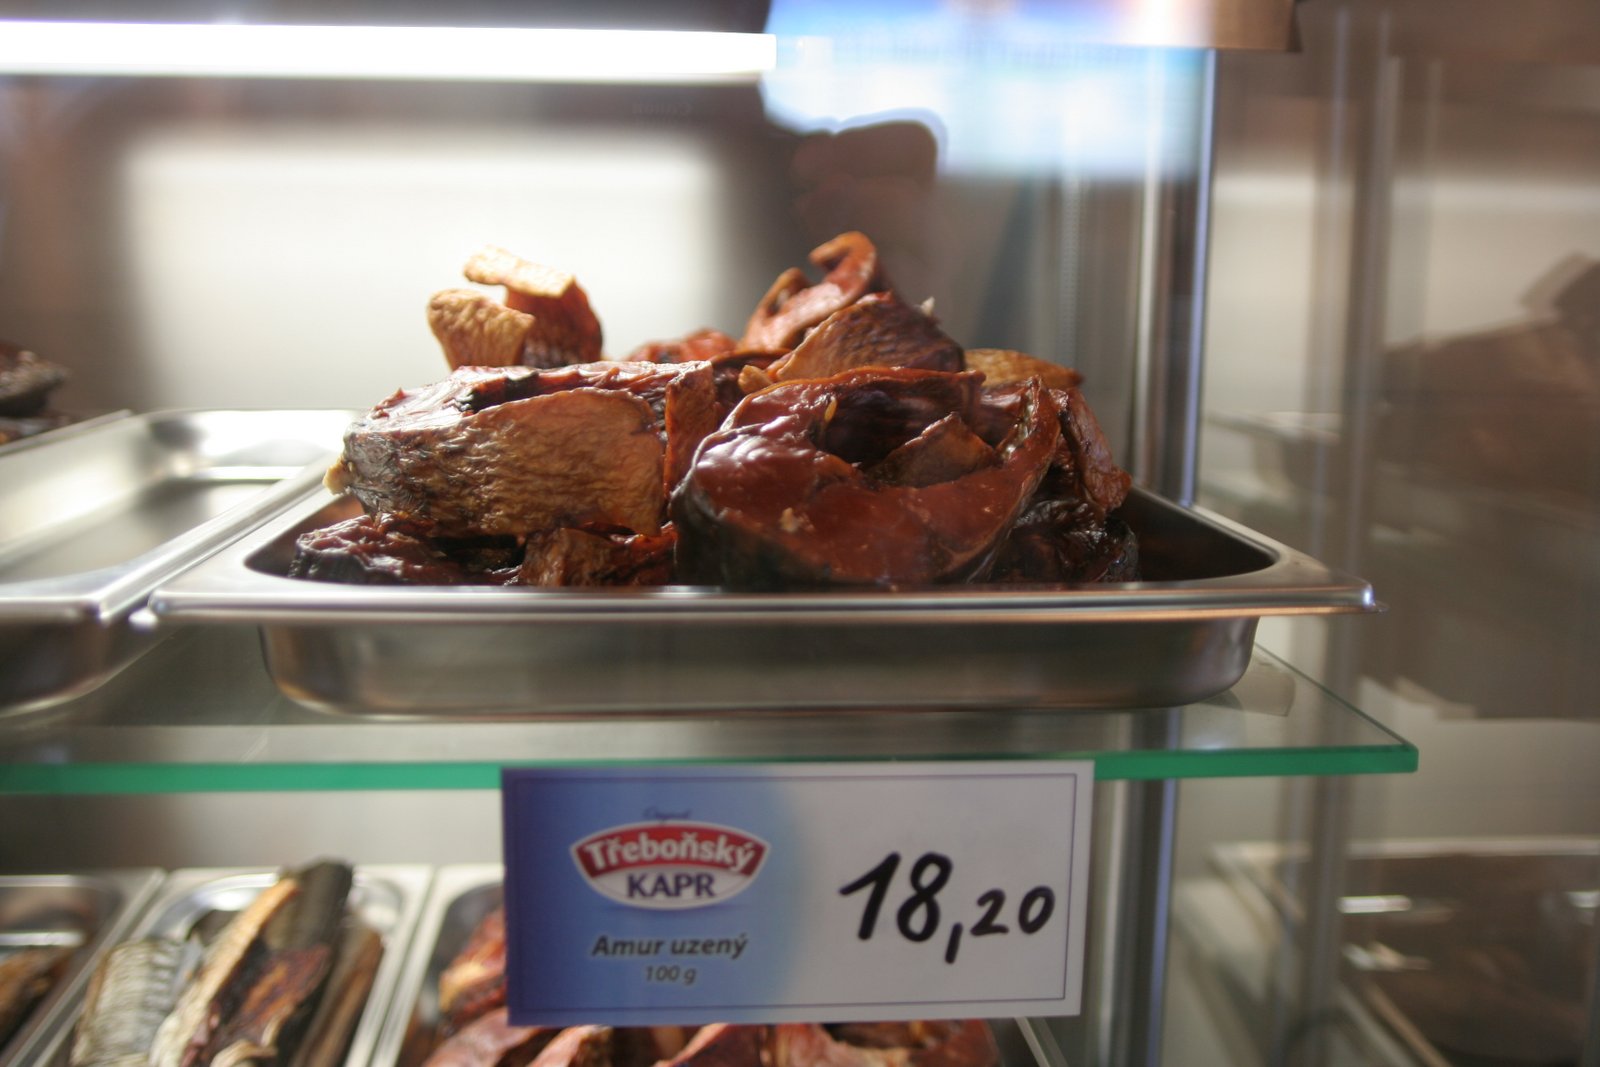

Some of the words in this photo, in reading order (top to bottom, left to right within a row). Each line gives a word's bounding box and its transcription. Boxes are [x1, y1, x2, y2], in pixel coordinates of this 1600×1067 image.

[582, 831, 756, 873] Třeboňský
[627, 873, 716, 898] KAPR
[839, 851, 1056, 965] 18,20
[592, 935, 664, 956] Amur
[670, 932, 748, 959] uzený
[645, 965, 681, 982] 100
[683, 968, 698, 986] g
